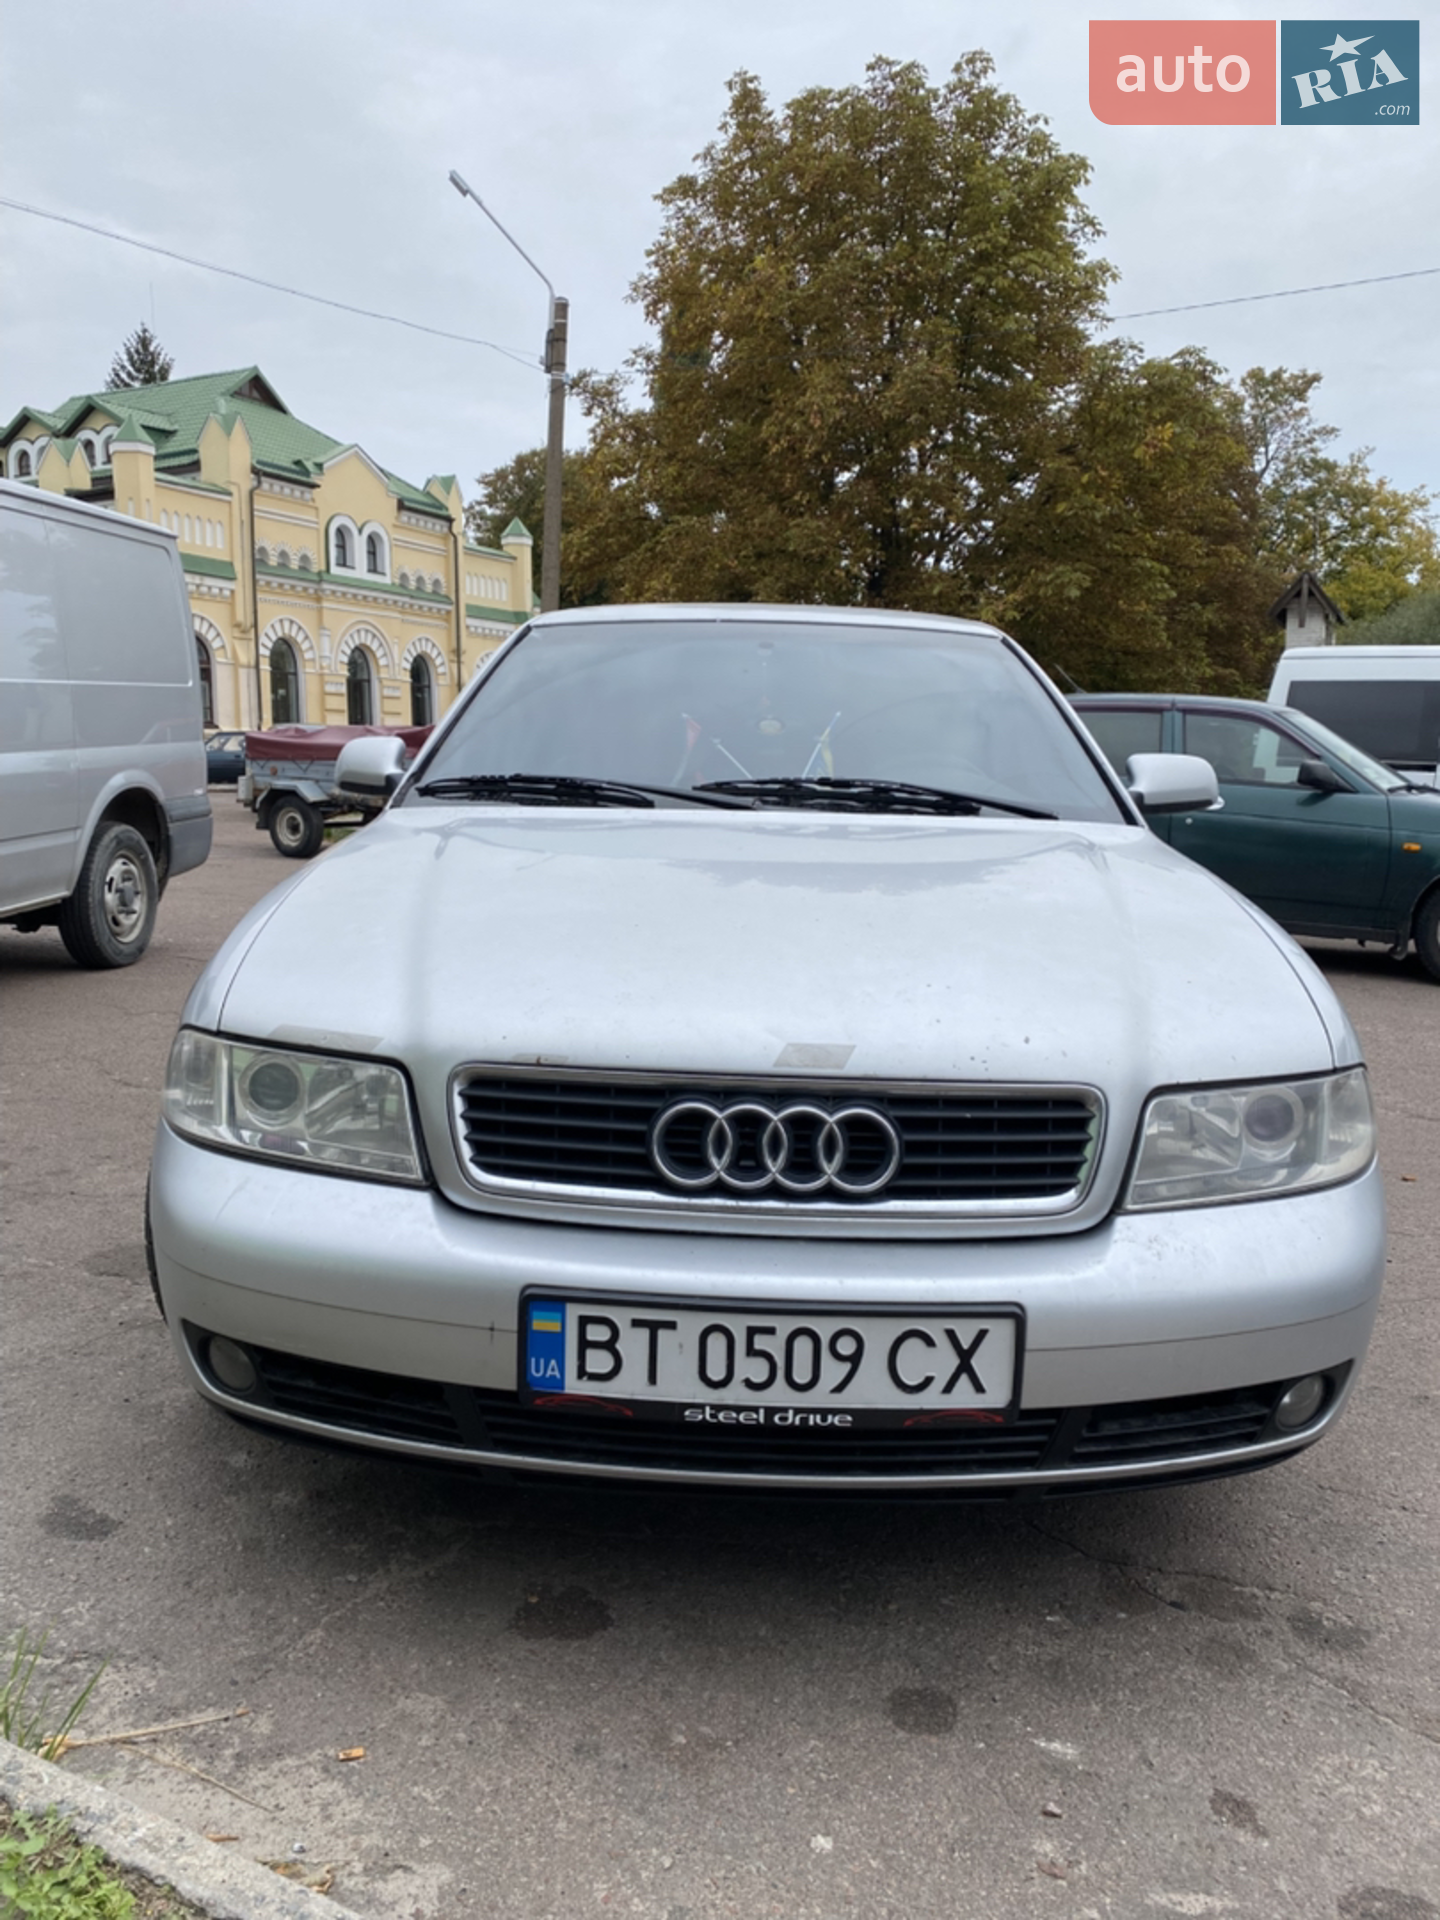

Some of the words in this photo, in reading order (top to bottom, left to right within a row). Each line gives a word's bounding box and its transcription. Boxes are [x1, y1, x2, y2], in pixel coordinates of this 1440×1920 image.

[577, 1314, 678, 1386] BT
[698, 1323, 866, 1395] 0509
[887, 1327, 990, 1395] CX
[531, 1357, 561, 1379] UA
[684, 1405, 765, 1425] steel
[773, 1408, 853, 1427] drive
